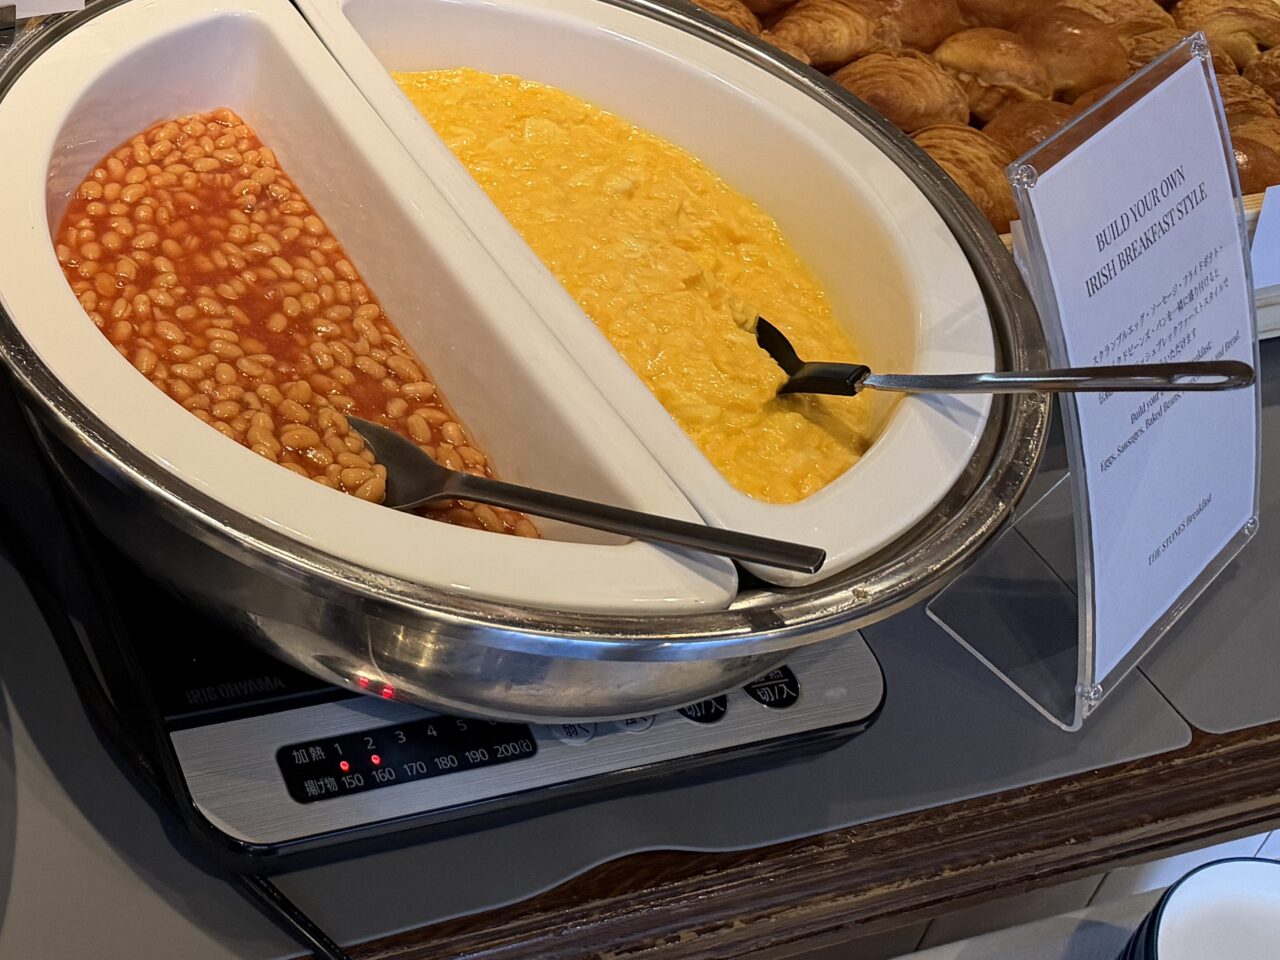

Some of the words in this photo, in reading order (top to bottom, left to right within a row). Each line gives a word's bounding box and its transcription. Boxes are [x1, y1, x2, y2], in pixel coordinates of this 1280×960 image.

[1095, 212, 1131, 253] BUILD
[1129, 187, 1162, 224] YOUR
[1160, 164, 1187, 199] OWN
[1084, 259, 1119, 298] IRISH
[1117, 213, 1178, 272] BREAKFAST
[1174, 181, 1209, 222] STYLE
[1130, 402, 1147, 425] Build
[1145, 410, 1163, 430] Baked
[185, 686, 218, 704] IRIS
[219, 676, 286, 699] OHYAMA
[292, 745, 326, 764] 加熱
[333, 742, 344, 756] 1
[363, 737, 377, 750] 2
[394, 730, 407, 744] 3
[426, 725, 439, 737] 4
[456, 719, 468, 732] 5
[304, 777, 339, 797] 揚げ物
[341, 773, 365, 790] 150
[371, 767, 397, 783] 160
[403, 761, 428, 777] 170
[434, 754, 459, 770] 180
[464, 748, 489, 764] 190
